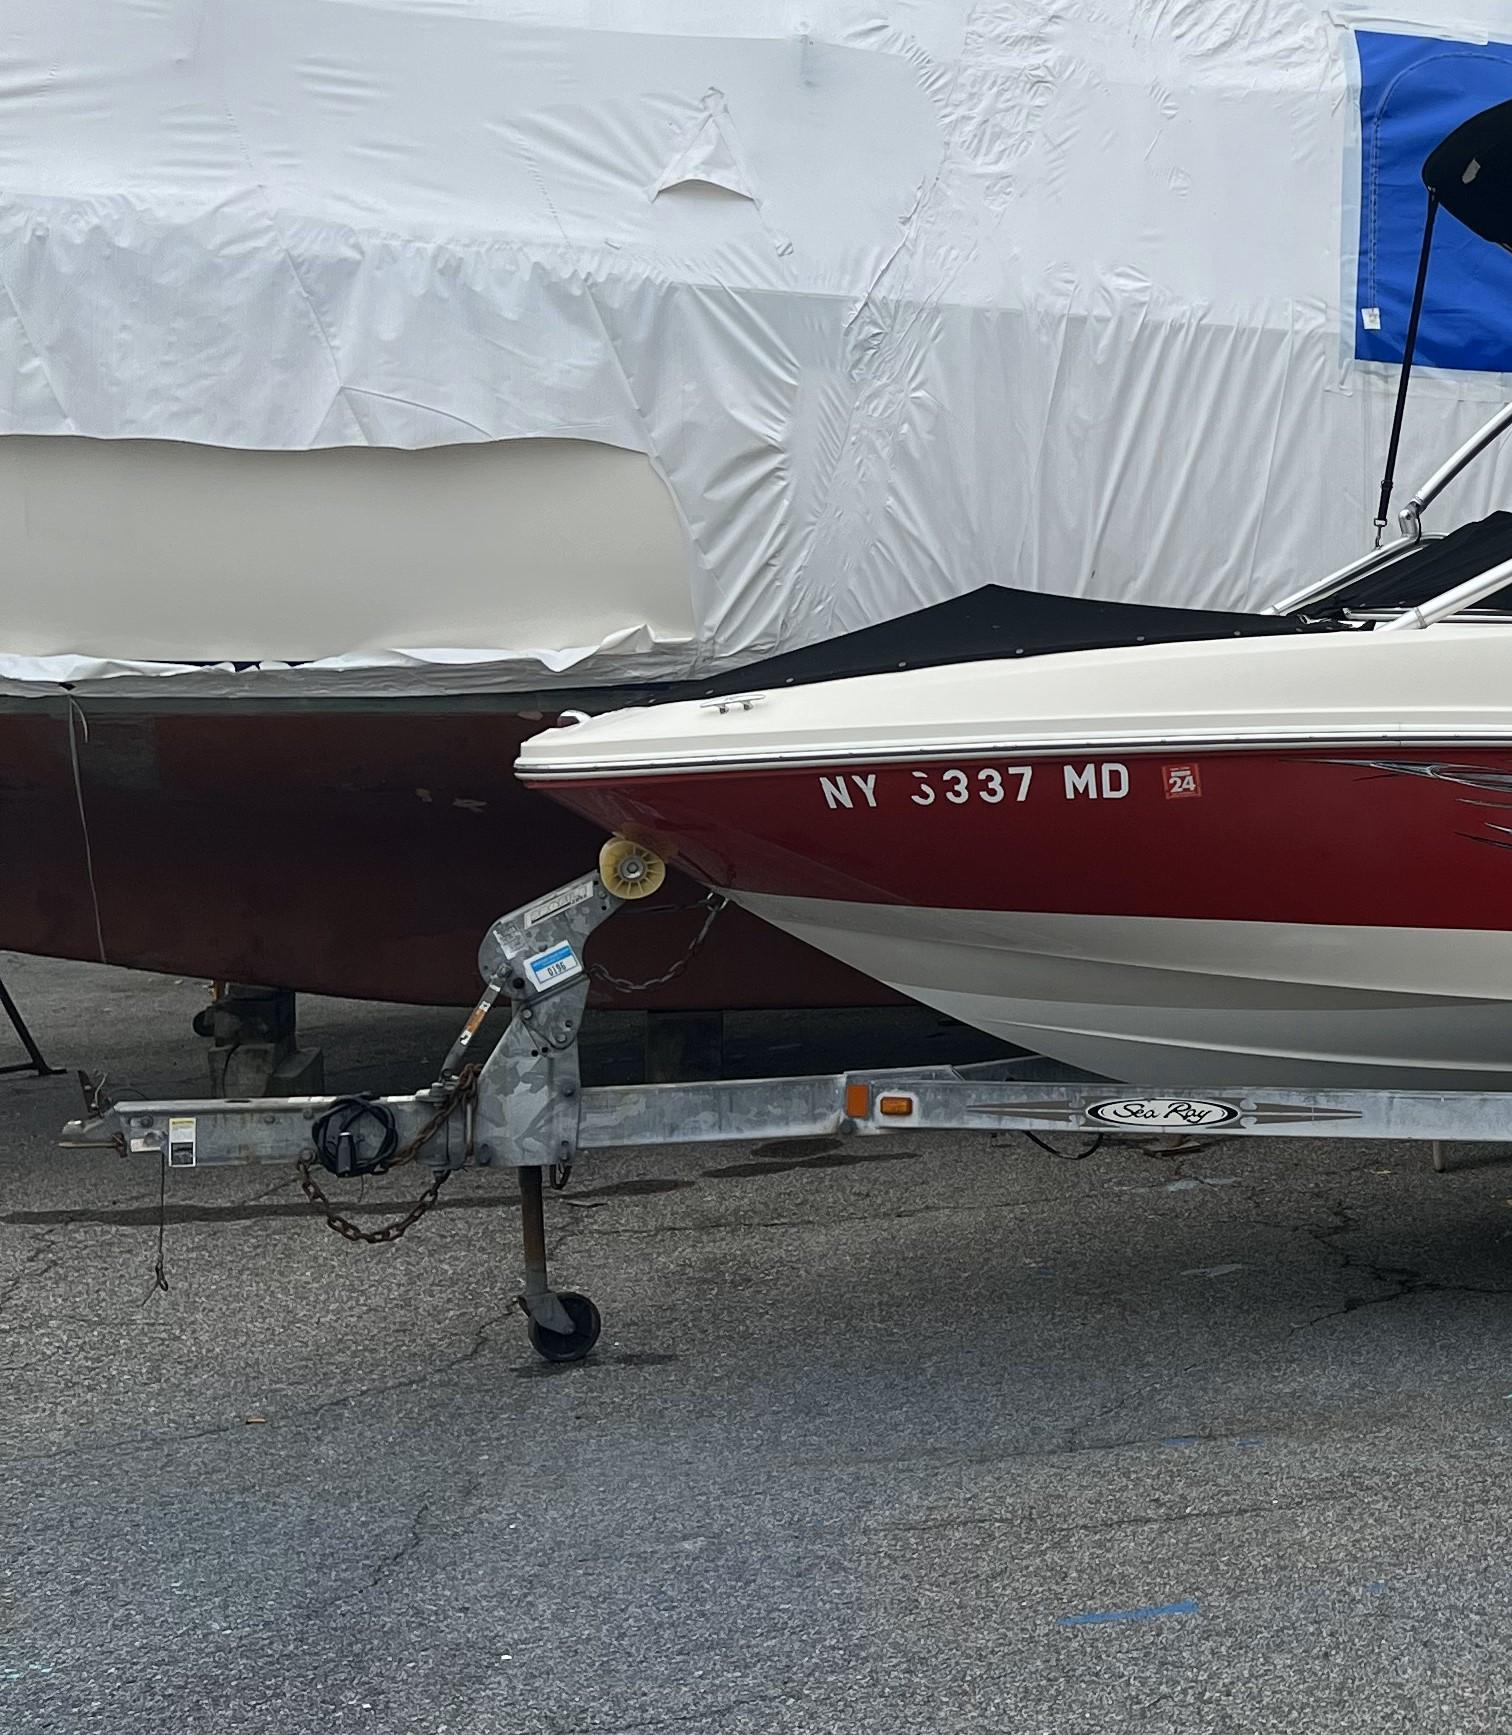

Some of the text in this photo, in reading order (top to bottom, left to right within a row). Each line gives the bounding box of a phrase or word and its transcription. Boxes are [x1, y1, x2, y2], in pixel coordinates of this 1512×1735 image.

[819, 774, 877, 808] NY
[1063, 762, 1129, 799] MD
[1168, 775, 1196, 793] 24
[1113, 1101, 1213, 1124] Sea Ray
